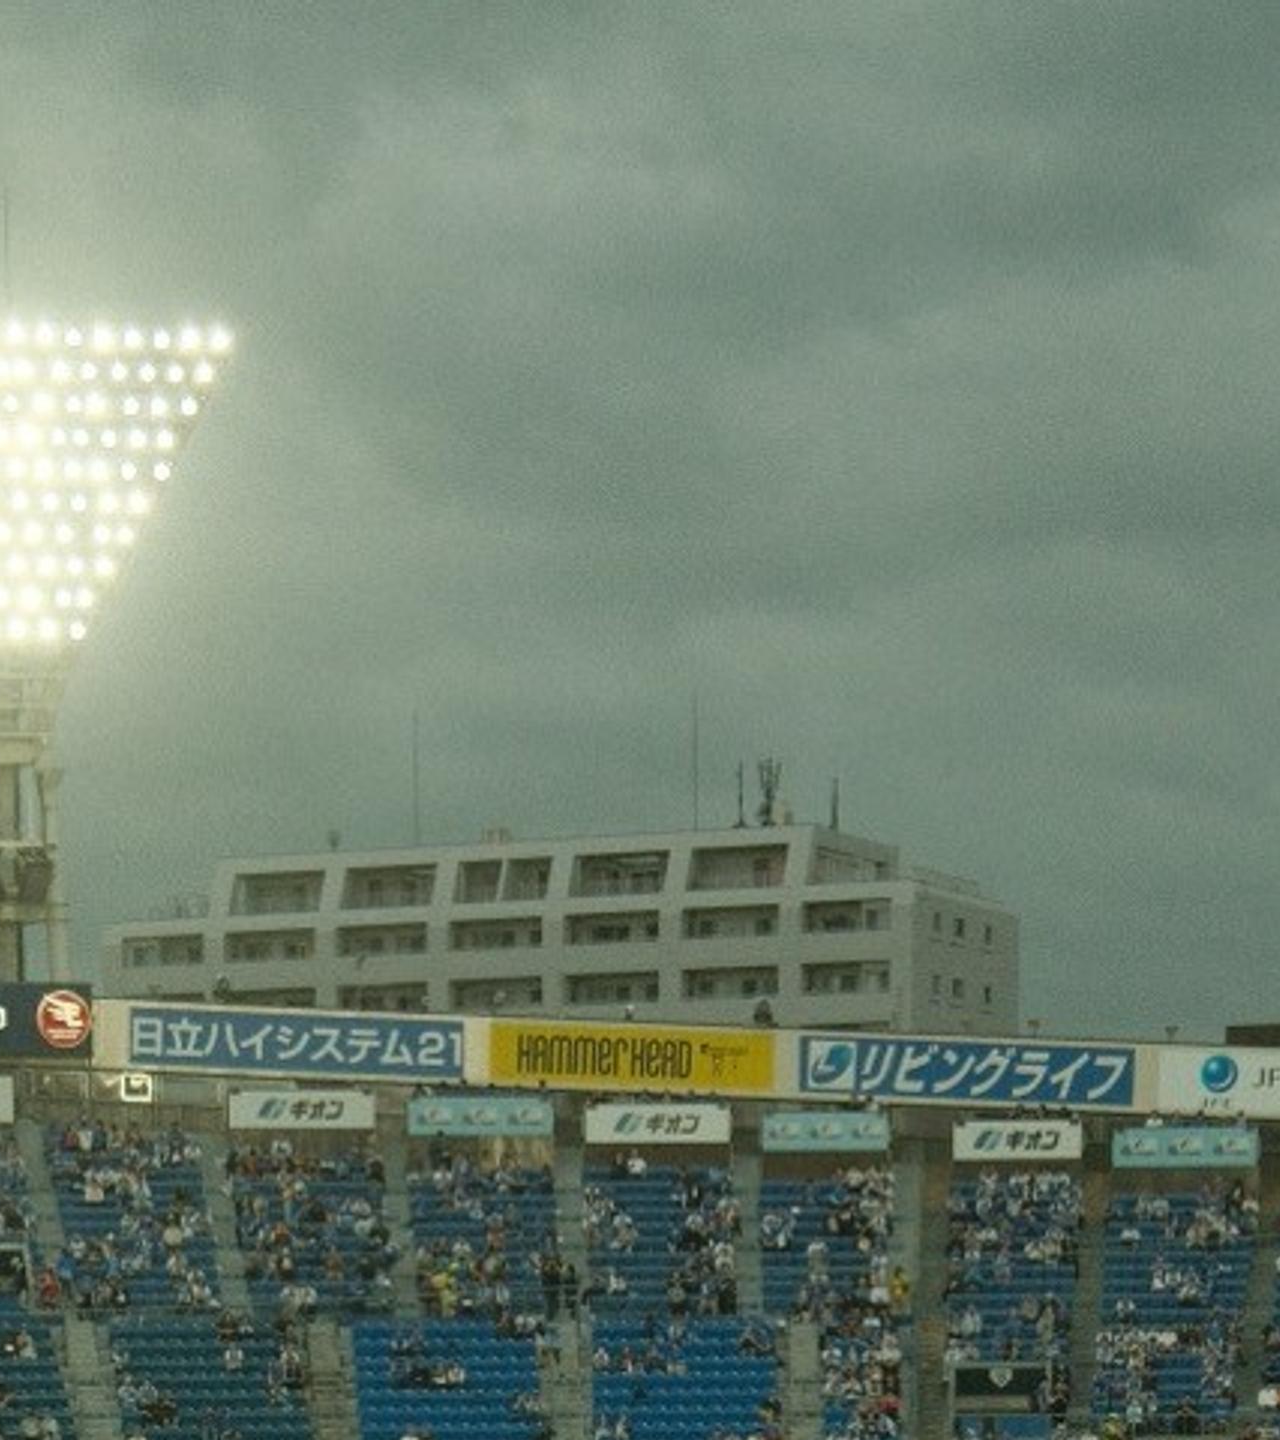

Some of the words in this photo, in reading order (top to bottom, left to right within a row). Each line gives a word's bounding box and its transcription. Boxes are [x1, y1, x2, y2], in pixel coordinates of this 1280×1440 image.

[132, 1017, 462, 1067] 日立ハイシステム21
[862, 1044, 1128, 1099] リビングライフ
